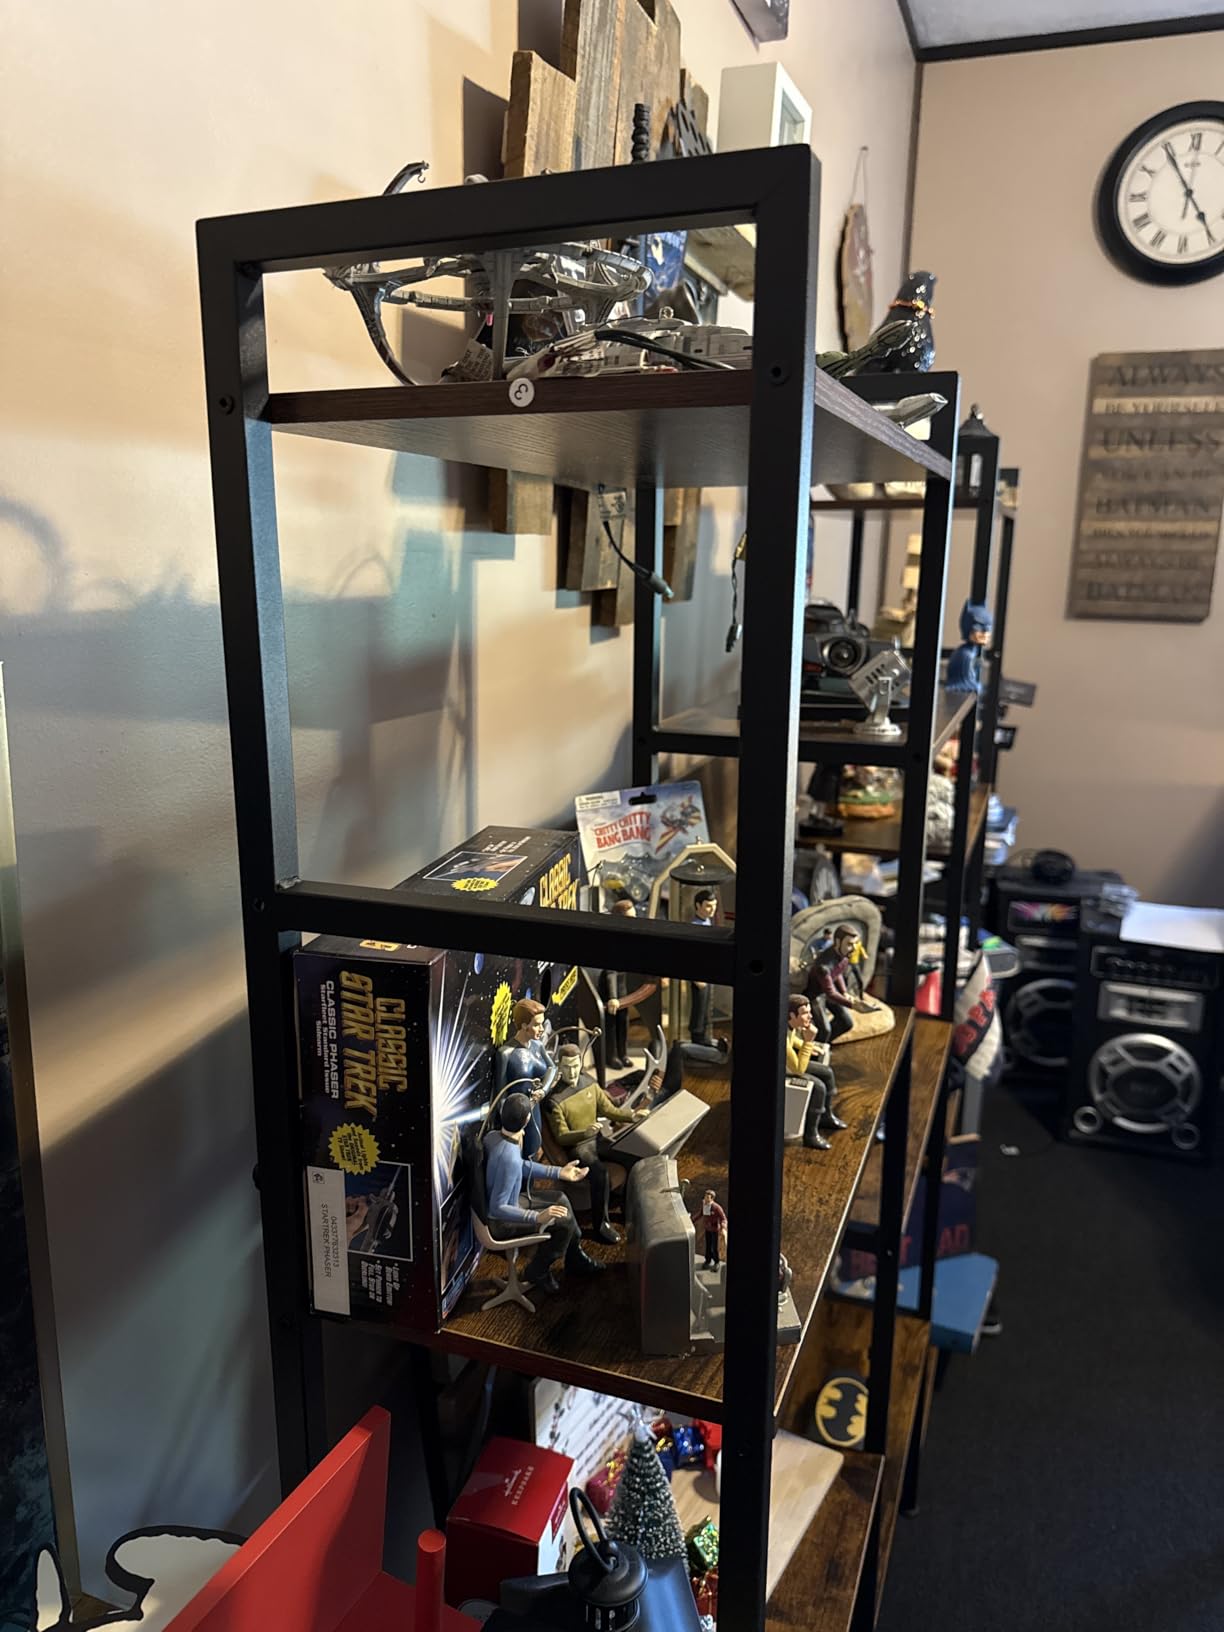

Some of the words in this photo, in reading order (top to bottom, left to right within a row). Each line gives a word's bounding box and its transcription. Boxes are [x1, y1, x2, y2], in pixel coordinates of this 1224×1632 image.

[594, 820, 619, 836] CHITTY
[620, 811, 652, 827] CHITTY
[596, 832, 621, 849] BANG
[621, 826, 652, 843] BANG
[320, 984, 328, 1024] Starfleet
[326, 980, 337, 1040] CLASSIC
[339, 970, 376, 1041] STAR
[322, 1026, 330, 1068] Standard
[375, 997, 408, 1092] CLASSIC
[330, 1043, 340, 1099] PHASER
[343, 1047, 378, 1117] TREK
[324, 1246, 332, 1278] PHASER
